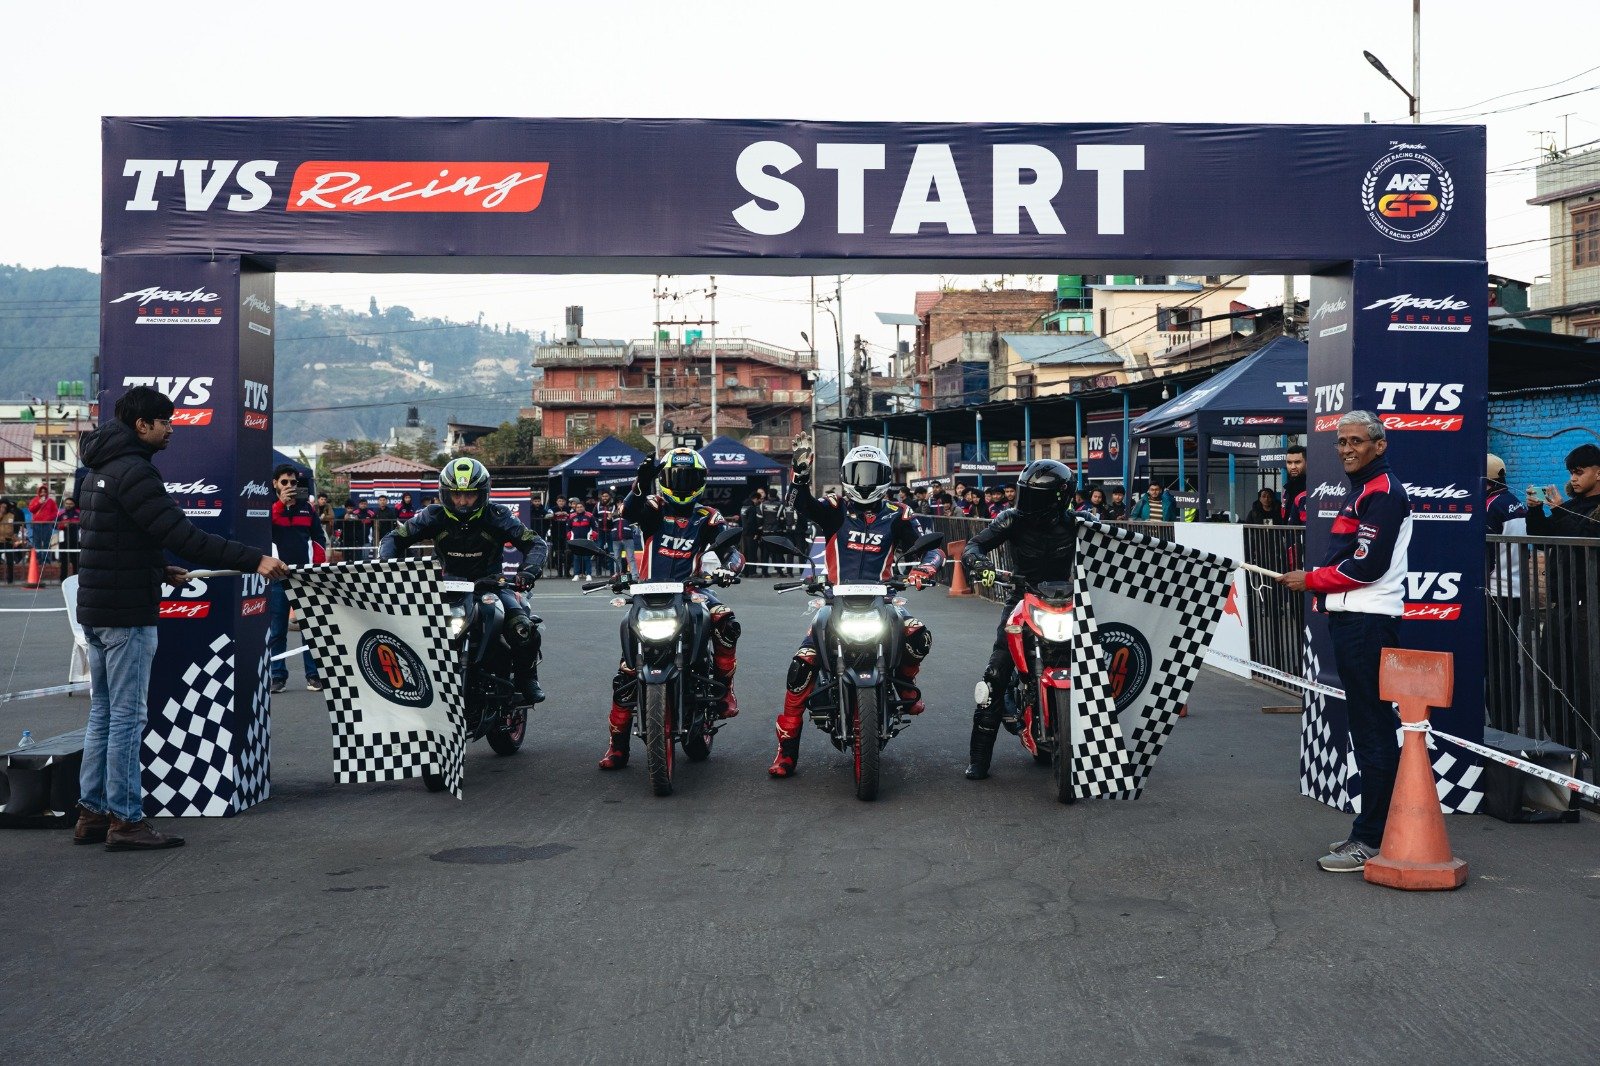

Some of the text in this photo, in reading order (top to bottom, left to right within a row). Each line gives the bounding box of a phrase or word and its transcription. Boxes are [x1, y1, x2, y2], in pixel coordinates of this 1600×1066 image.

[1372, 152, 1444, 175] APACHE RACING EXPERIENCE
[122, 159, 543, 211] TVS Racing
[731, 140, 1146, 236] START
[1378, 193, 1438, 218] GP
[1369, 212, 1446, 240] ULTIMATE RACING CHAMPIONSHIP
[109, 286, 221, 307] Apache
[1362, 293, 1470, 313] Apache
[138, 307, 222, 315] SERIES
[1390, 314, 1472, 322] SERIES
[244, 379, 269, 411] TVS
[1314, 382, 1345, 413] TVS
[1375, 382, 1465, 412] TVS
[1222, 416, 1245, 425] TVS
[1383, 416, 1462, 430] Racing
[1088, 436, 1104, 450] TVS
[598, 455, 632, 463] TVS
[712, 453, 746, 461] TVS
[163, 478, 222, 494] ache
[240, 480, 270, 499] Apache
[1310, 481, 1347, 500] Apache
[660, 534, 695, 551] TVS
[848, 530, 884, 545] TVS
[241, 573, 267, 597] TVS
[1406, 571, 1462, 600] VS
[1403, 606, 1460, 618] cing
[376, 644, 404, 688] GP
